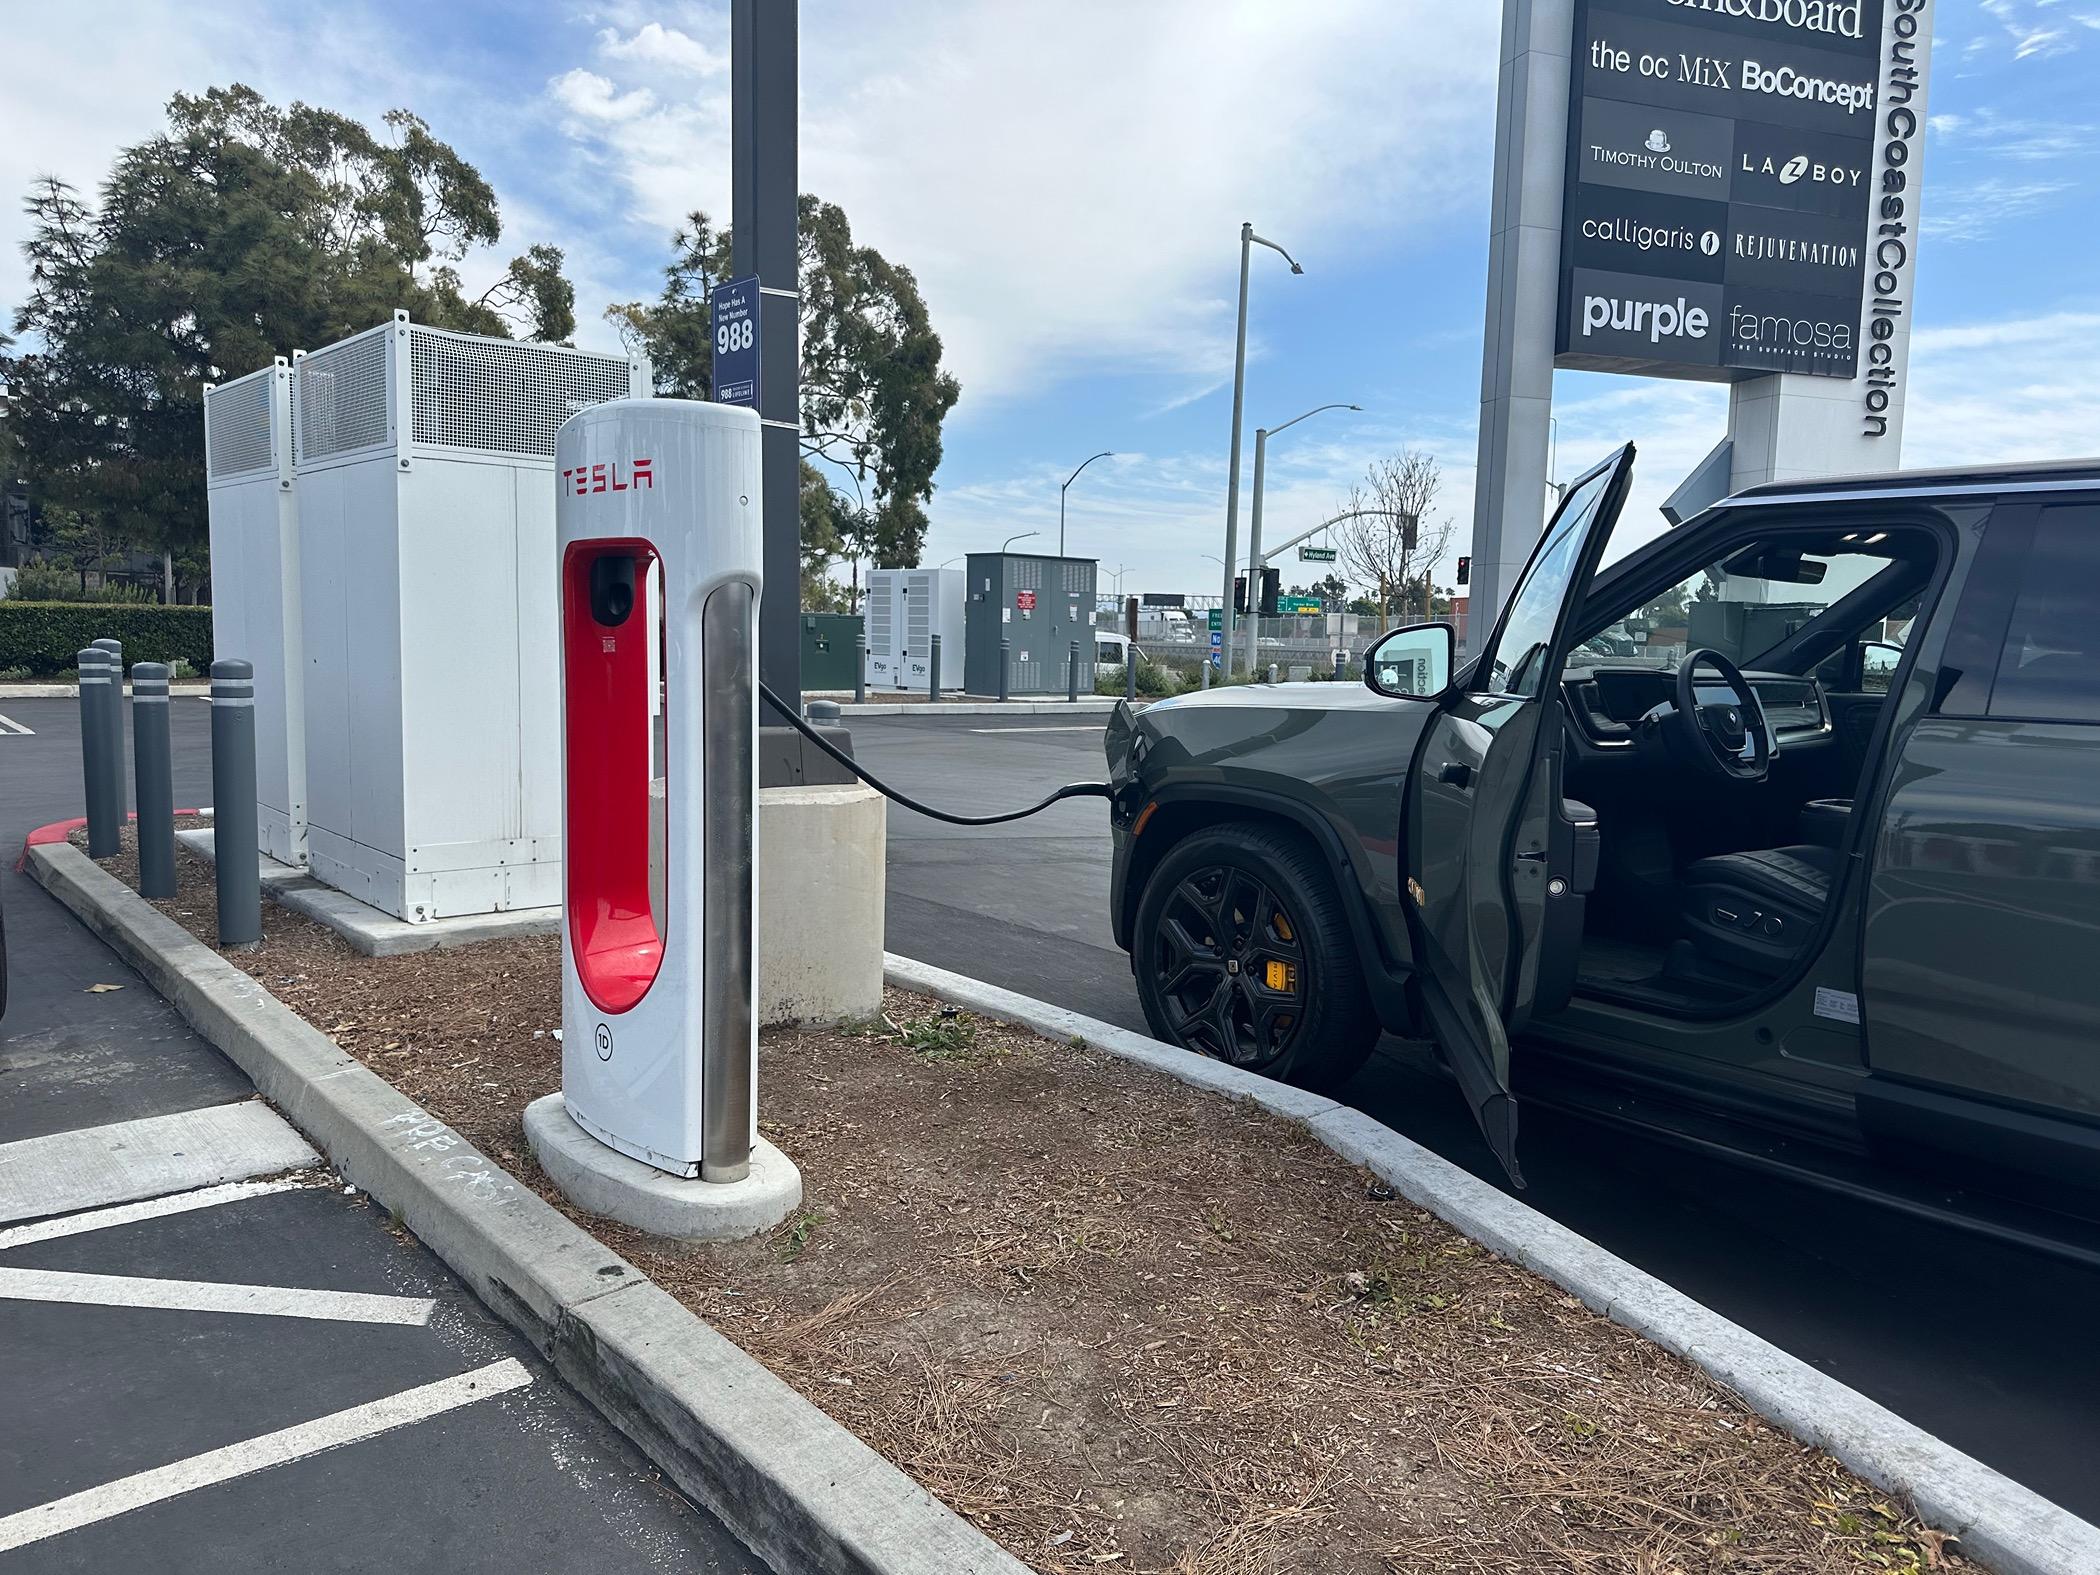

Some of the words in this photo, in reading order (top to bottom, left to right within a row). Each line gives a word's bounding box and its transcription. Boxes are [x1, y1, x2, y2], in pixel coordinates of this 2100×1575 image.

[1591, 40, 1631, 72] the
[1639, 55, 1669, 79] oc
[1741, 60, 1874, 114] BoConcept
[1582, 217, 1694, 251] calligaris
[1735, 233, 1858, 268] REJUVENATION
[718, 301, 731, 311] Hope
[731, 298, 741, 307] Has
[741, 295, 746, 304] A
[718, 314, 729, 323] New
[729, 308, 748, 320] Number
[1582, 295, 1710, 343] purple
[717, 318, 754, 355] 988
[1729, 304, 1852, 349] famosa
[1731, 343, 1751, 352] THE
[1758, 346, 1806, 357] SURFACE
[1813, 351, 1852, 361] STUDIO
[720, 388, 733, 400] 988
[563, 459, 652, 497] TESLA
[598, 1033, 609, 1049] 1D
